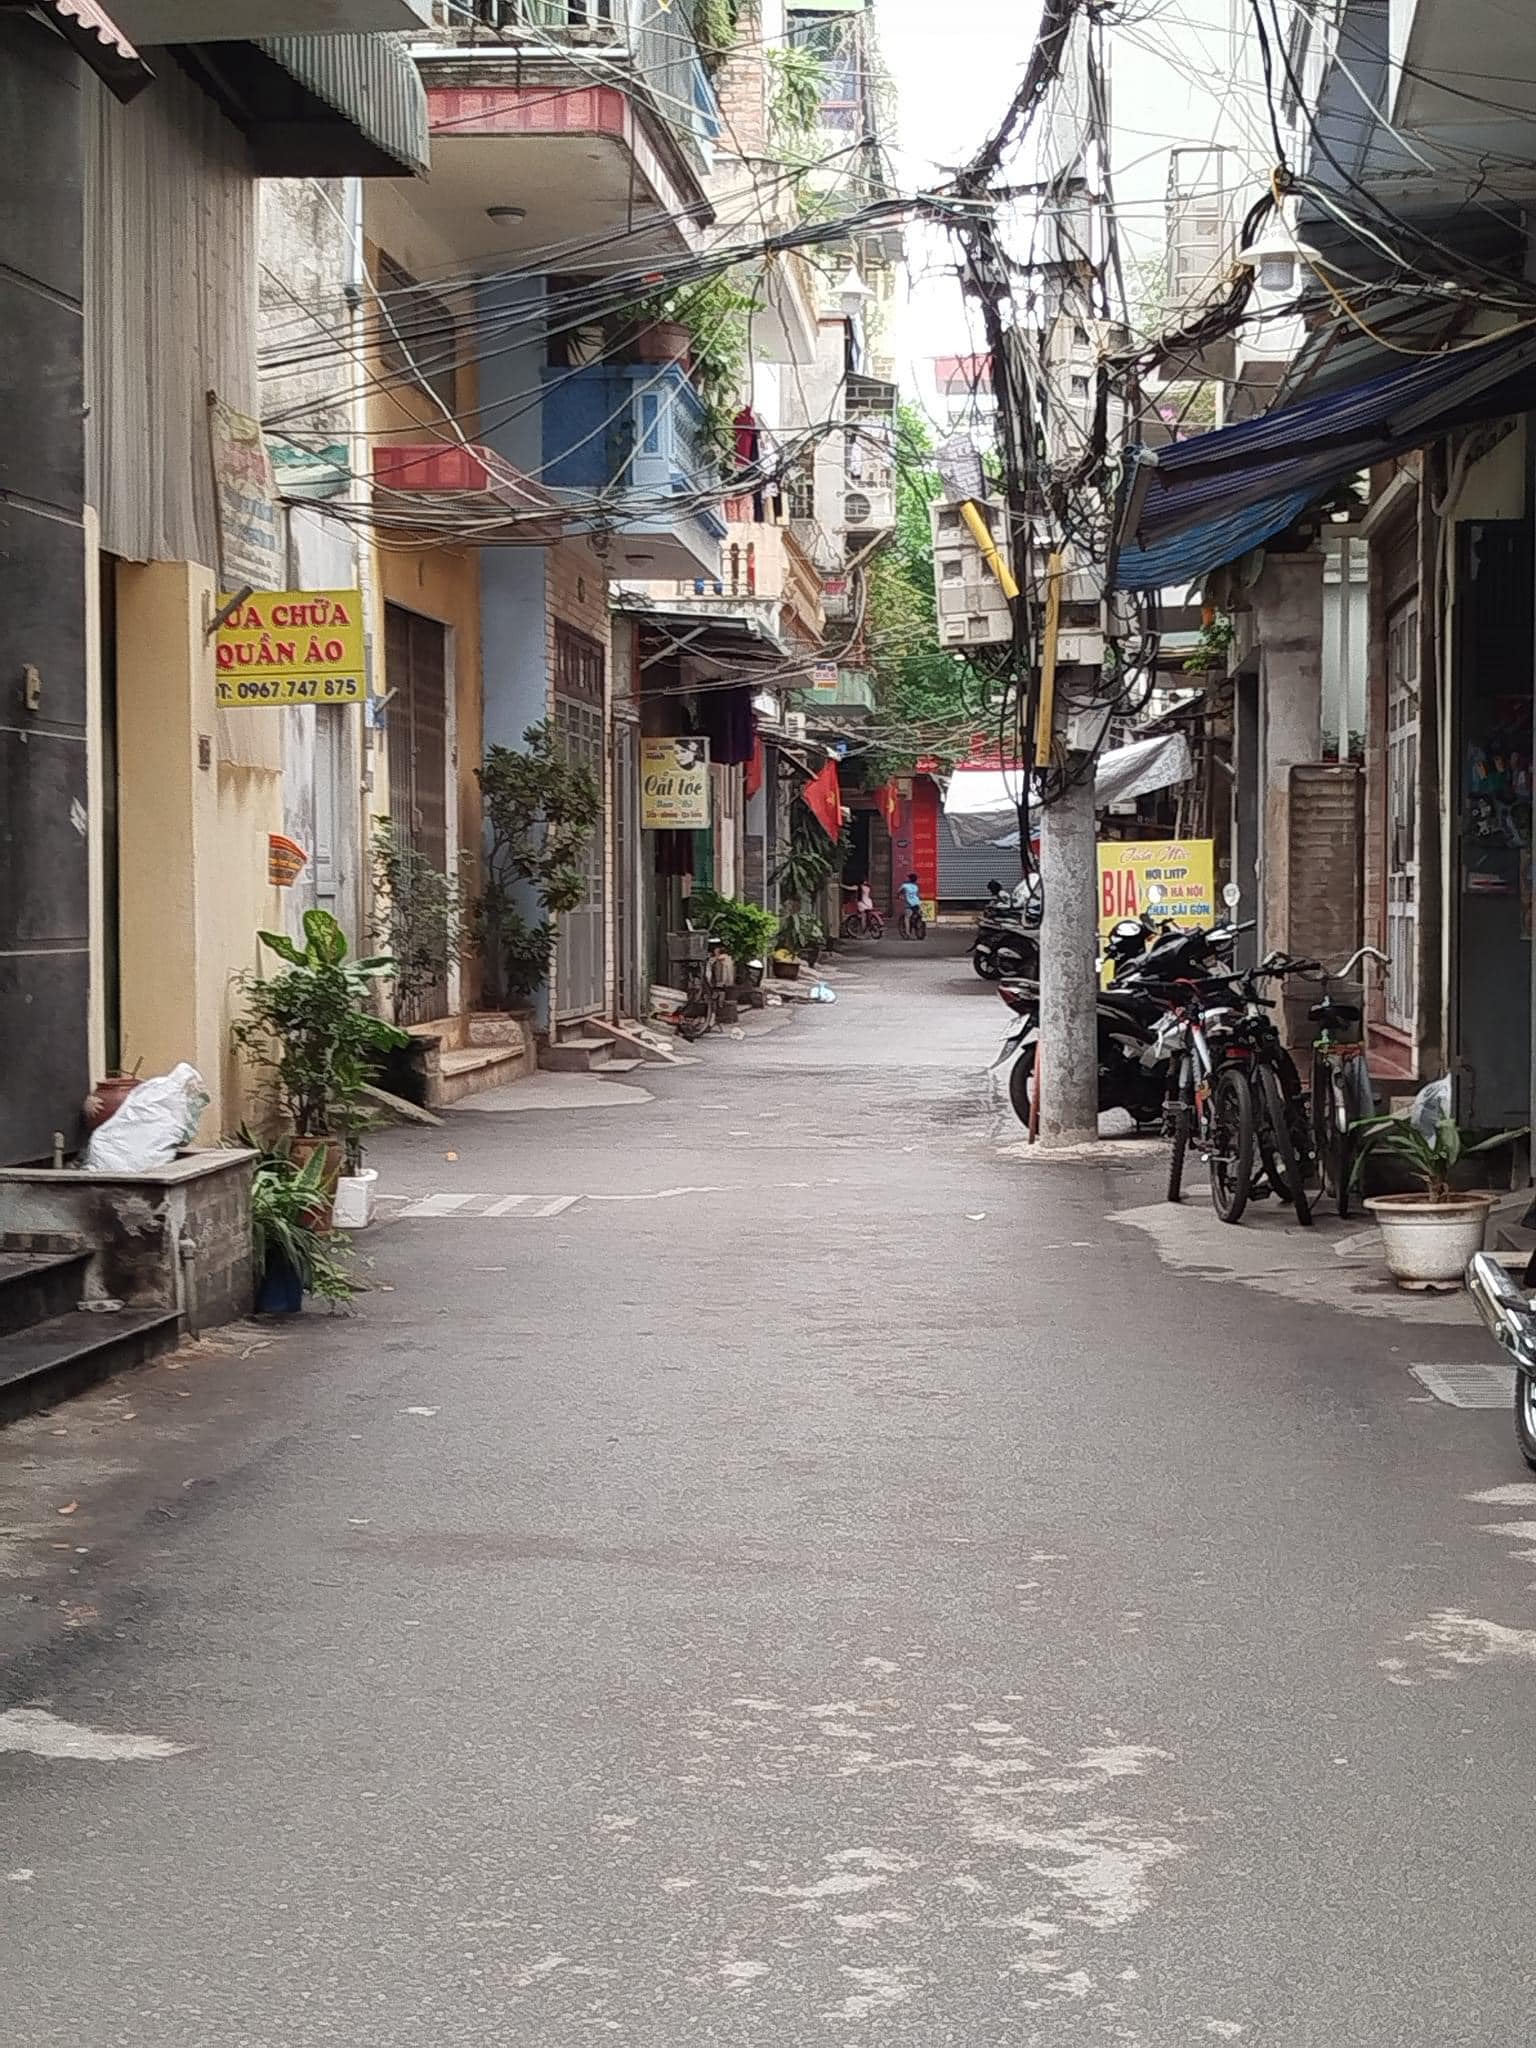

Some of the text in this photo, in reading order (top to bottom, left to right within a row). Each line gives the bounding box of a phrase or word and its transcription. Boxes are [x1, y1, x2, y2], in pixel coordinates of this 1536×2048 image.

[271, 597, 351, 627] CHỮA
[216, 632, 297, 669] QUẦN
[324, 679, 357, 695] 875
[1102, 869, 1138, 917] BIA
[1186, 884, 1204, 897] NỘI
